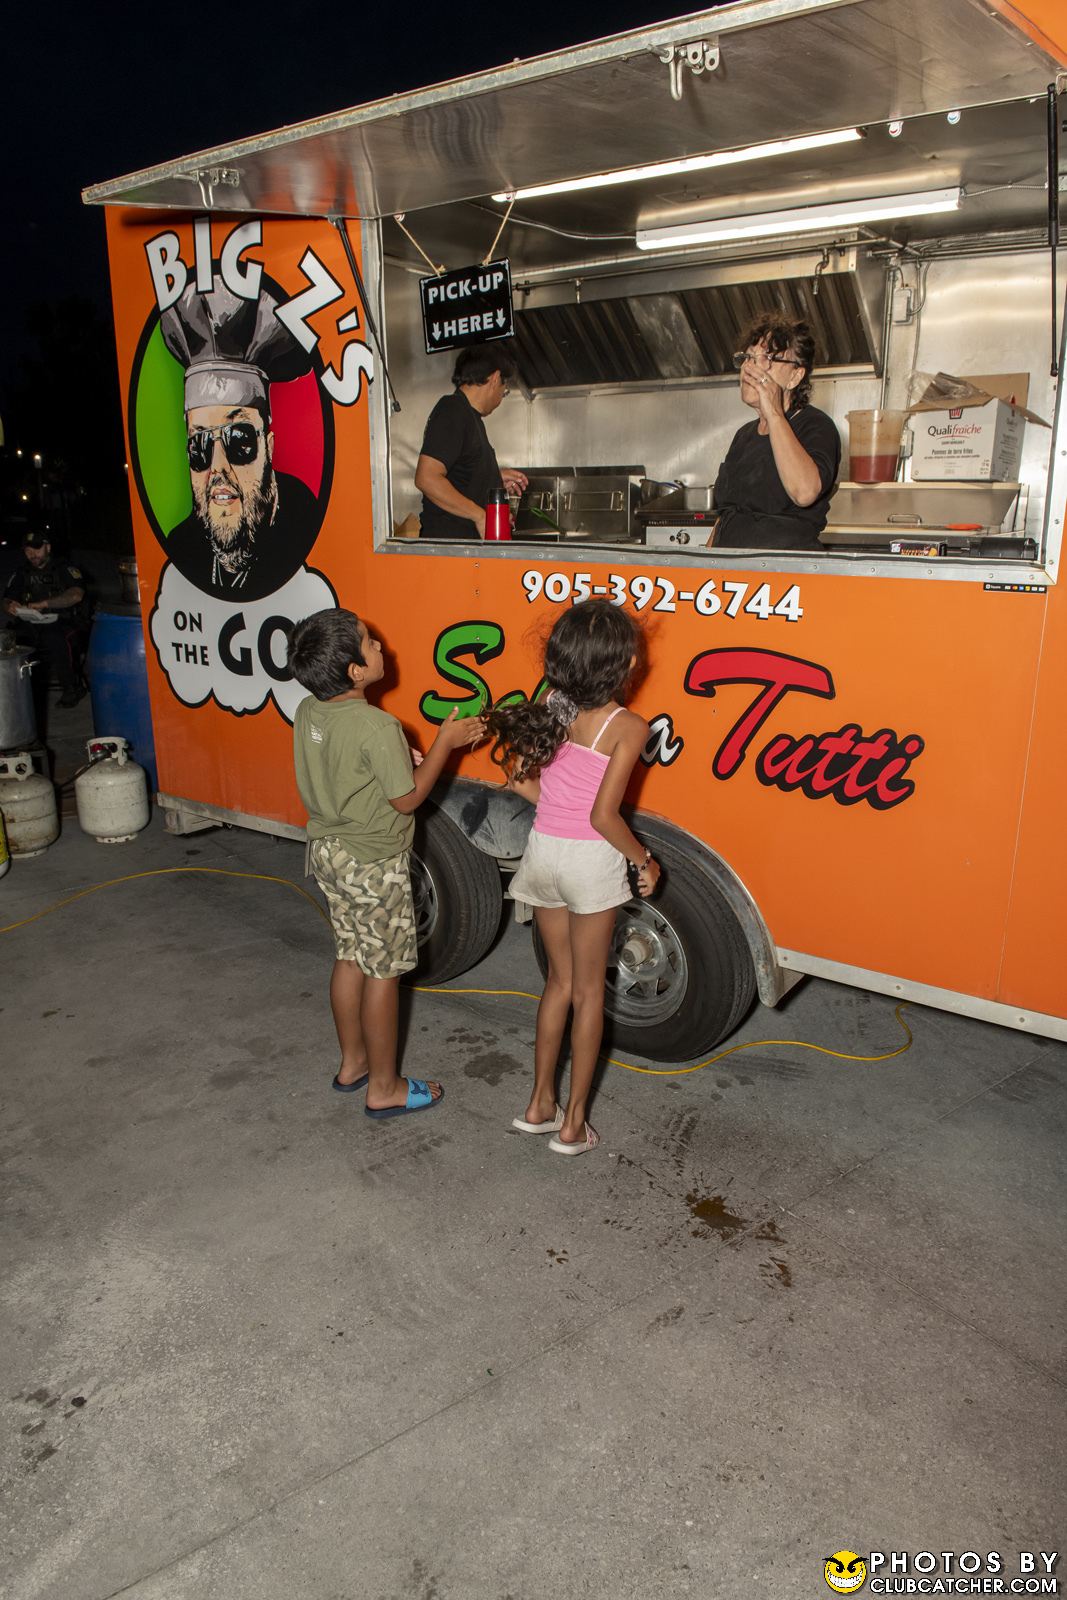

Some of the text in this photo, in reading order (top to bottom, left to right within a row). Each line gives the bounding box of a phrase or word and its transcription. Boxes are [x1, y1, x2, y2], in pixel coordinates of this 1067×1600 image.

[428, 271, 504, 305] PICK-UP
[144, 215, 374, 407] BIG Z'S
[443, 311, 495, 338] HERE
[521, 569, 804, 622] 905-392-6744
[173, 610, 203, 633] ON
[171, 642, 210, 667] THE
[217, 611, 298, 682] GO
[683, 647, 925, 811] Tutti
